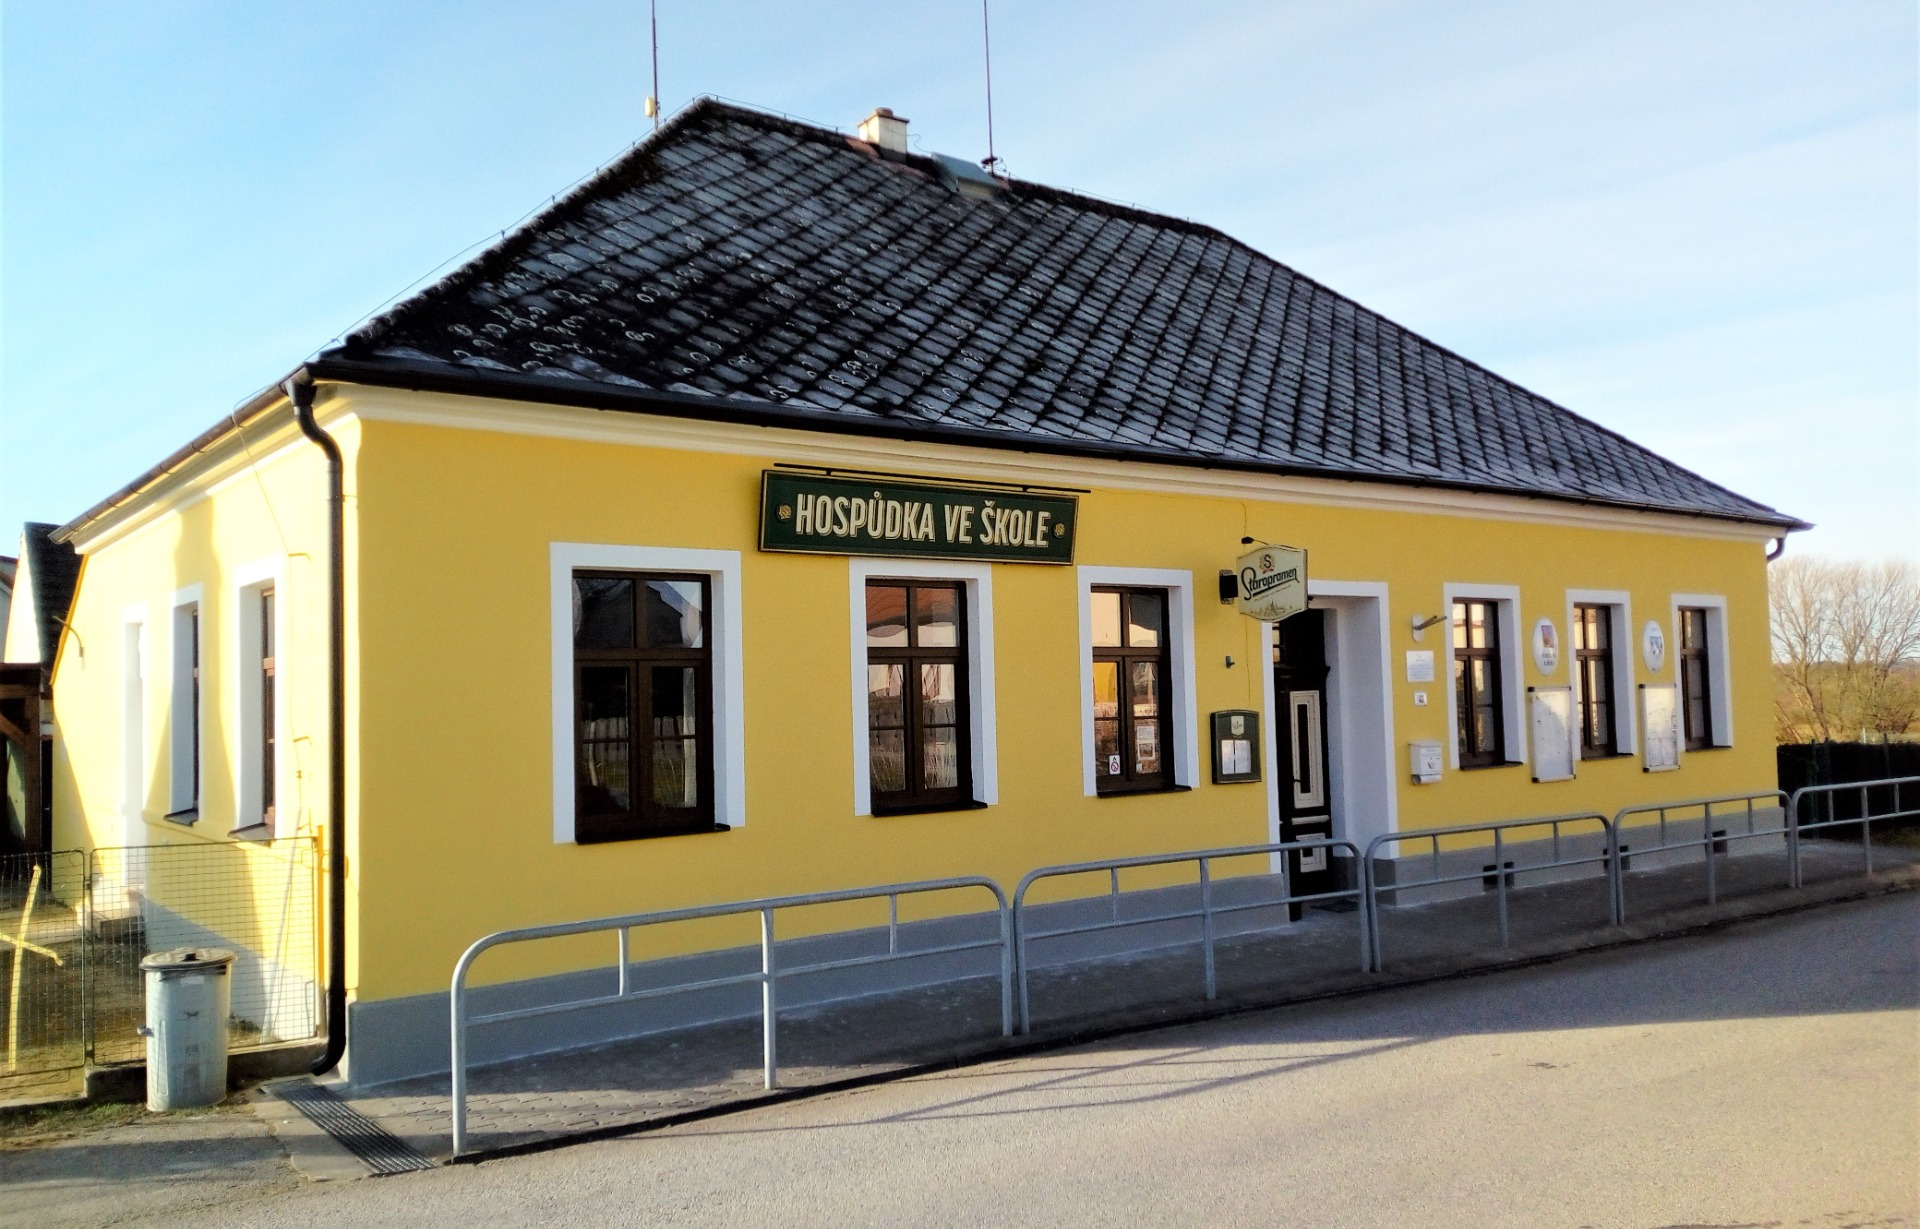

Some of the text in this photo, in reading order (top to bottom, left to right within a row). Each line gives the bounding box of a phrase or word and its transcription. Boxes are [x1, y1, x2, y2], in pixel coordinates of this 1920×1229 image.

[795, 490, 1052, 547] HOSPŮDKA VE ŠKOLE
[1241, 566, 1299, 601] Staropramen
